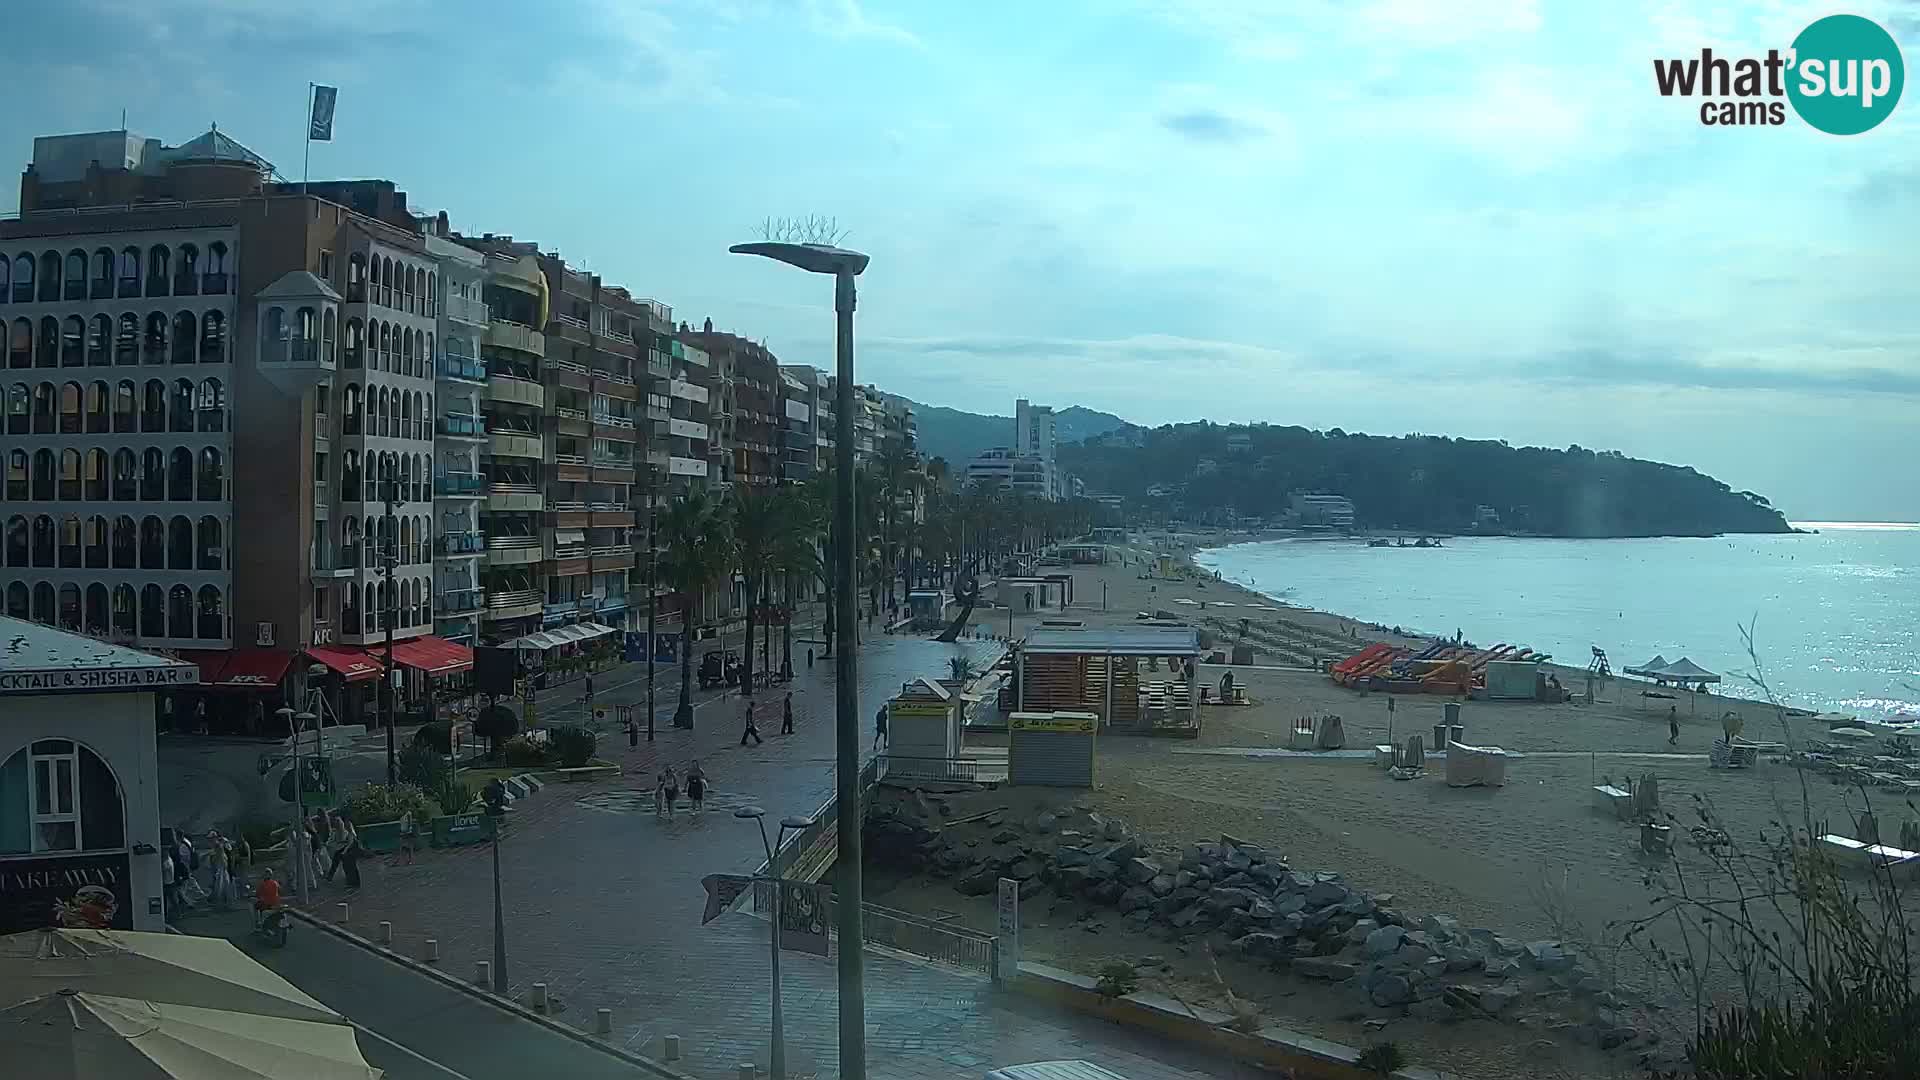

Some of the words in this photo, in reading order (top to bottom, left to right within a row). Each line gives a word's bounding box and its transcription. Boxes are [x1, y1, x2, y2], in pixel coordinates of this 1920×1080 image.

[313, 628, 333, 645] KFC
[0, 673, 58, 689] CKTAIL
[63, 672, 75, 686] &
[79, 671, 141, 687] SHISHA
[145, 669, 178, 684] BAR
